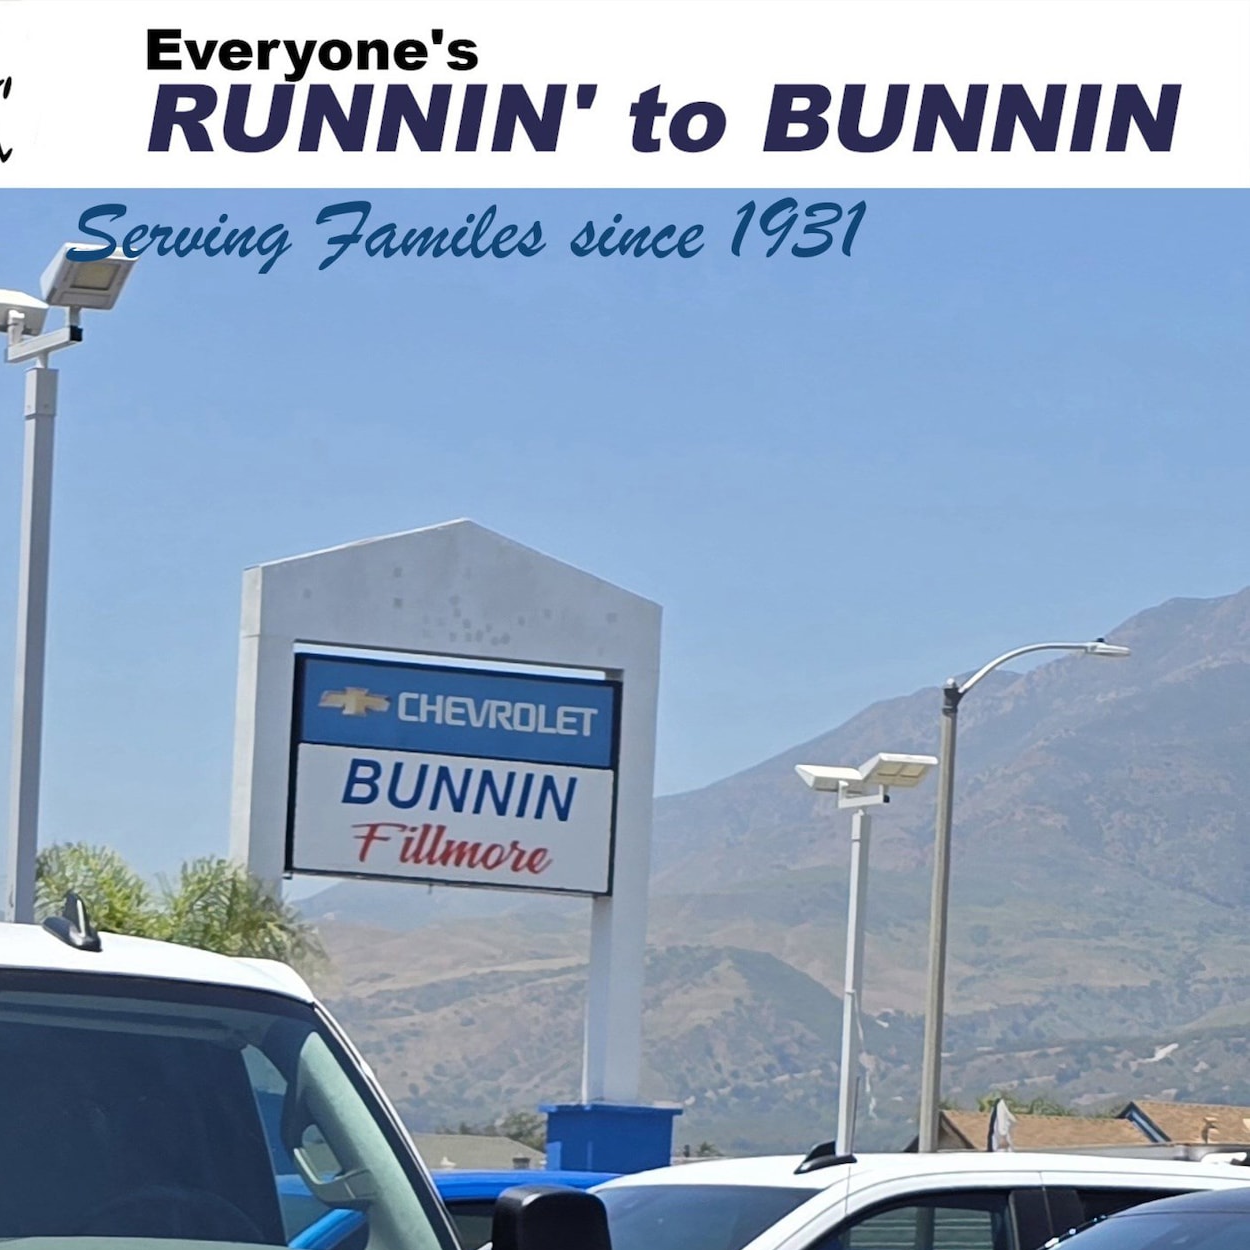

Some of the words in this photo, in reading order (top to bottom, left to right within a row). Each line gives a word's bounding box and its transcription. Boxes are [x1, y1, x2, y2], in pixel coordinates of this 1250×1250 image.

[398, 692, 598, 736] CHEVROLET
[341, 758, 578, 821] BUNNIN
[352, 822, 553, 874] Fillmore
